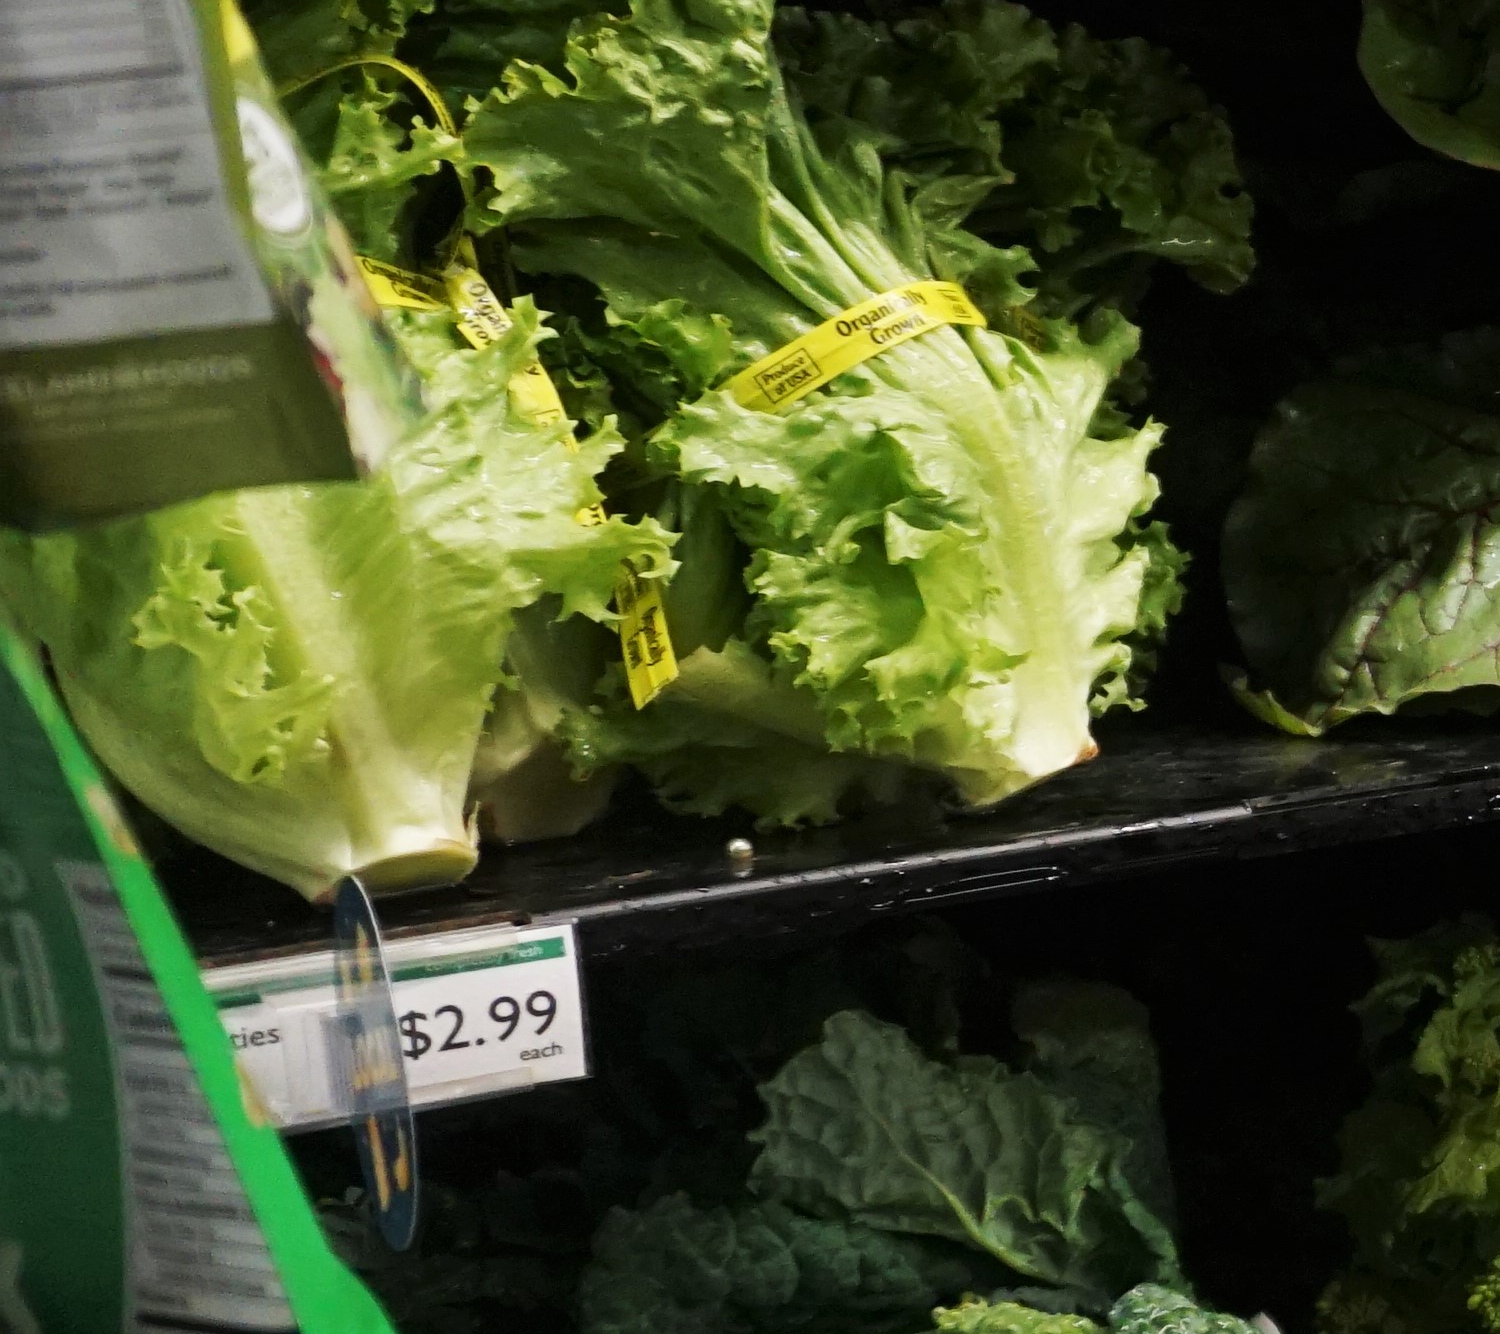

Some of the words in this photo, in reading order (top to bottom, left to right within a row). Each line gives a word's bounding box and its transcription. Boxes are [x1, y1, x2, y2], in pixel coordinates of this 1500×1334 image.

[836, 288, 929, 338] Organically
[869, 313, 926, 345] Grown
[761, 356, 805, 386] Produce
[789, 369, 812, 387] USA
[401, 990, 557, 1061] $2.99
[519, 1043, 563, 1062] each
